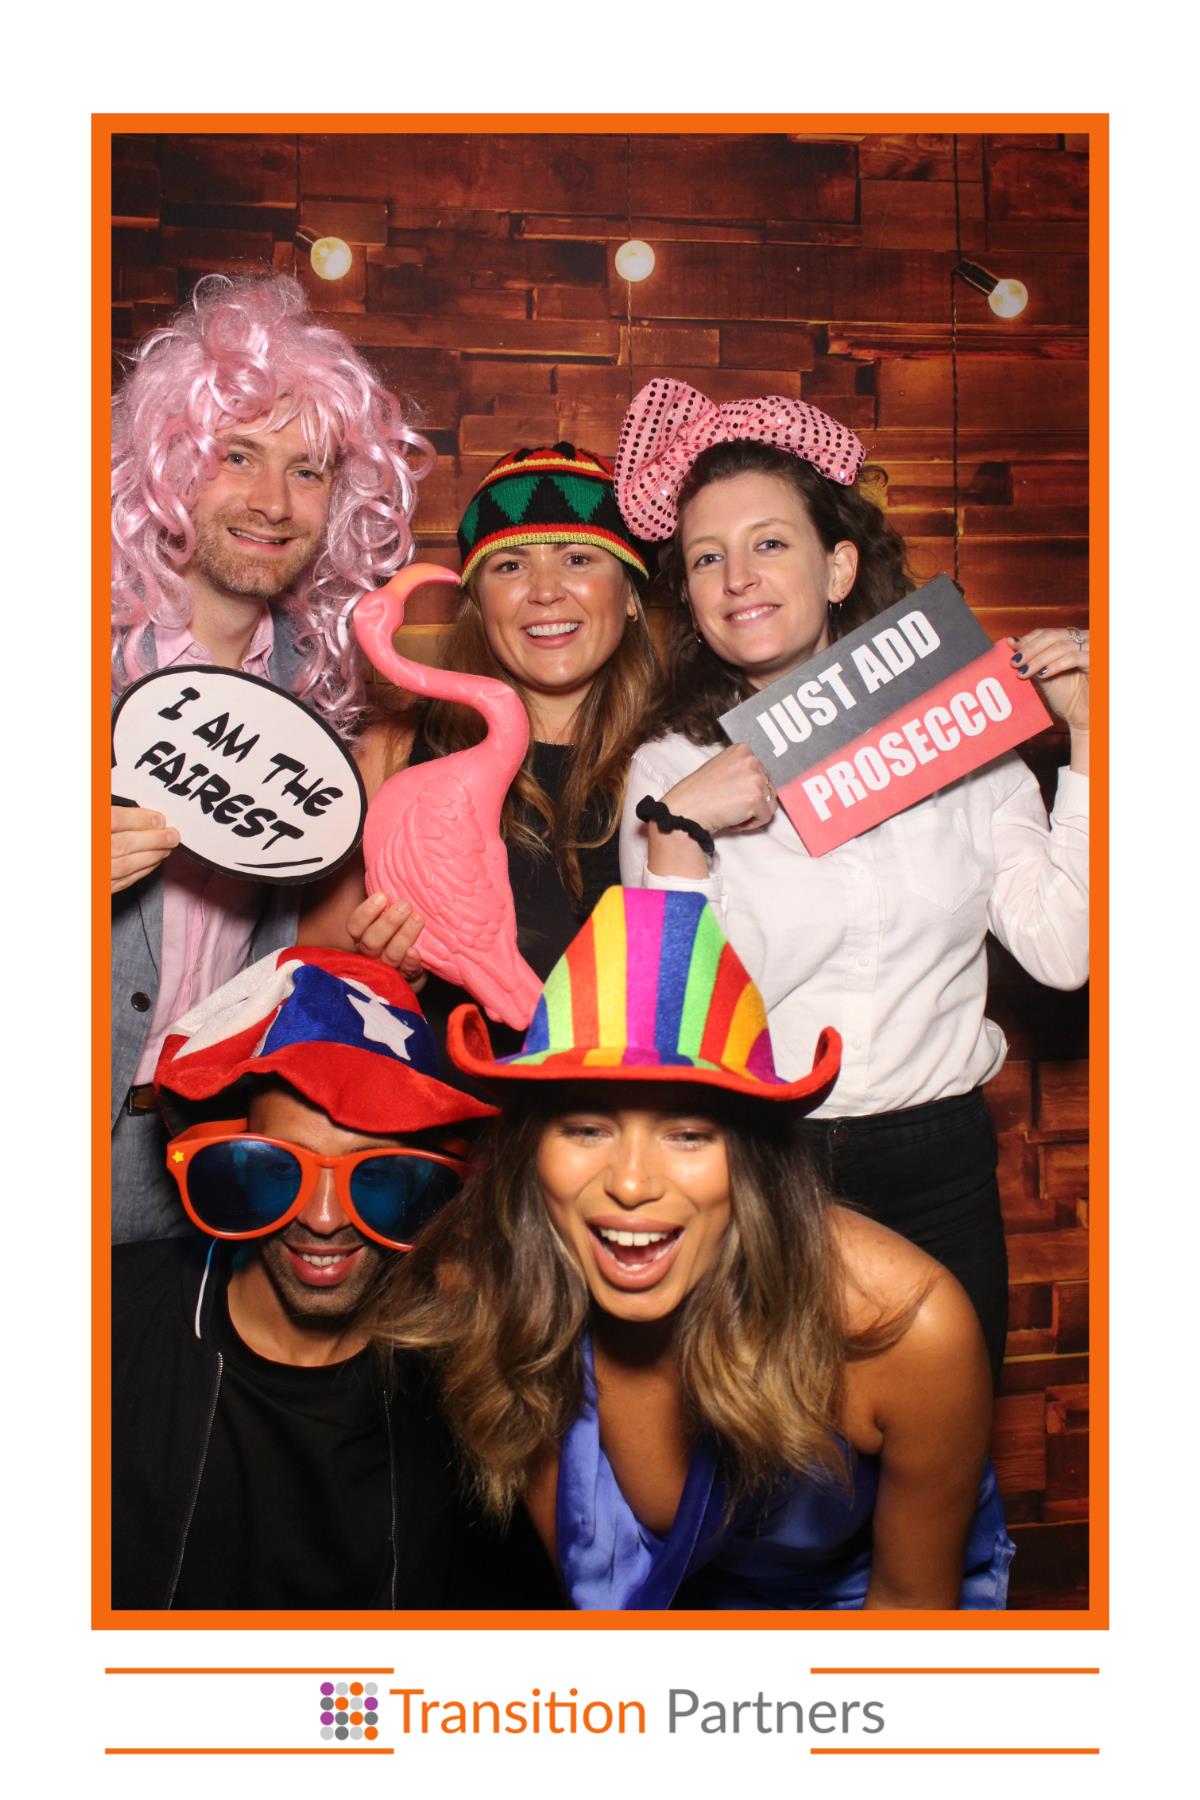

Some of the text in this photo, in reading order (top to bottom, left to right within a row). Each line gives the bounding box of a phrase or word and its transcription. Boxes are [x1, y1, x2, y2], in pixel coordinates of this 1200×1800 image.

[158, 687, 344, 816] I AM THE
[756, 610, 941, 758] JUST ADD
[802, 677, 1013, 822] PROSECCO
[134, 741, 304, 850] FAIREST
